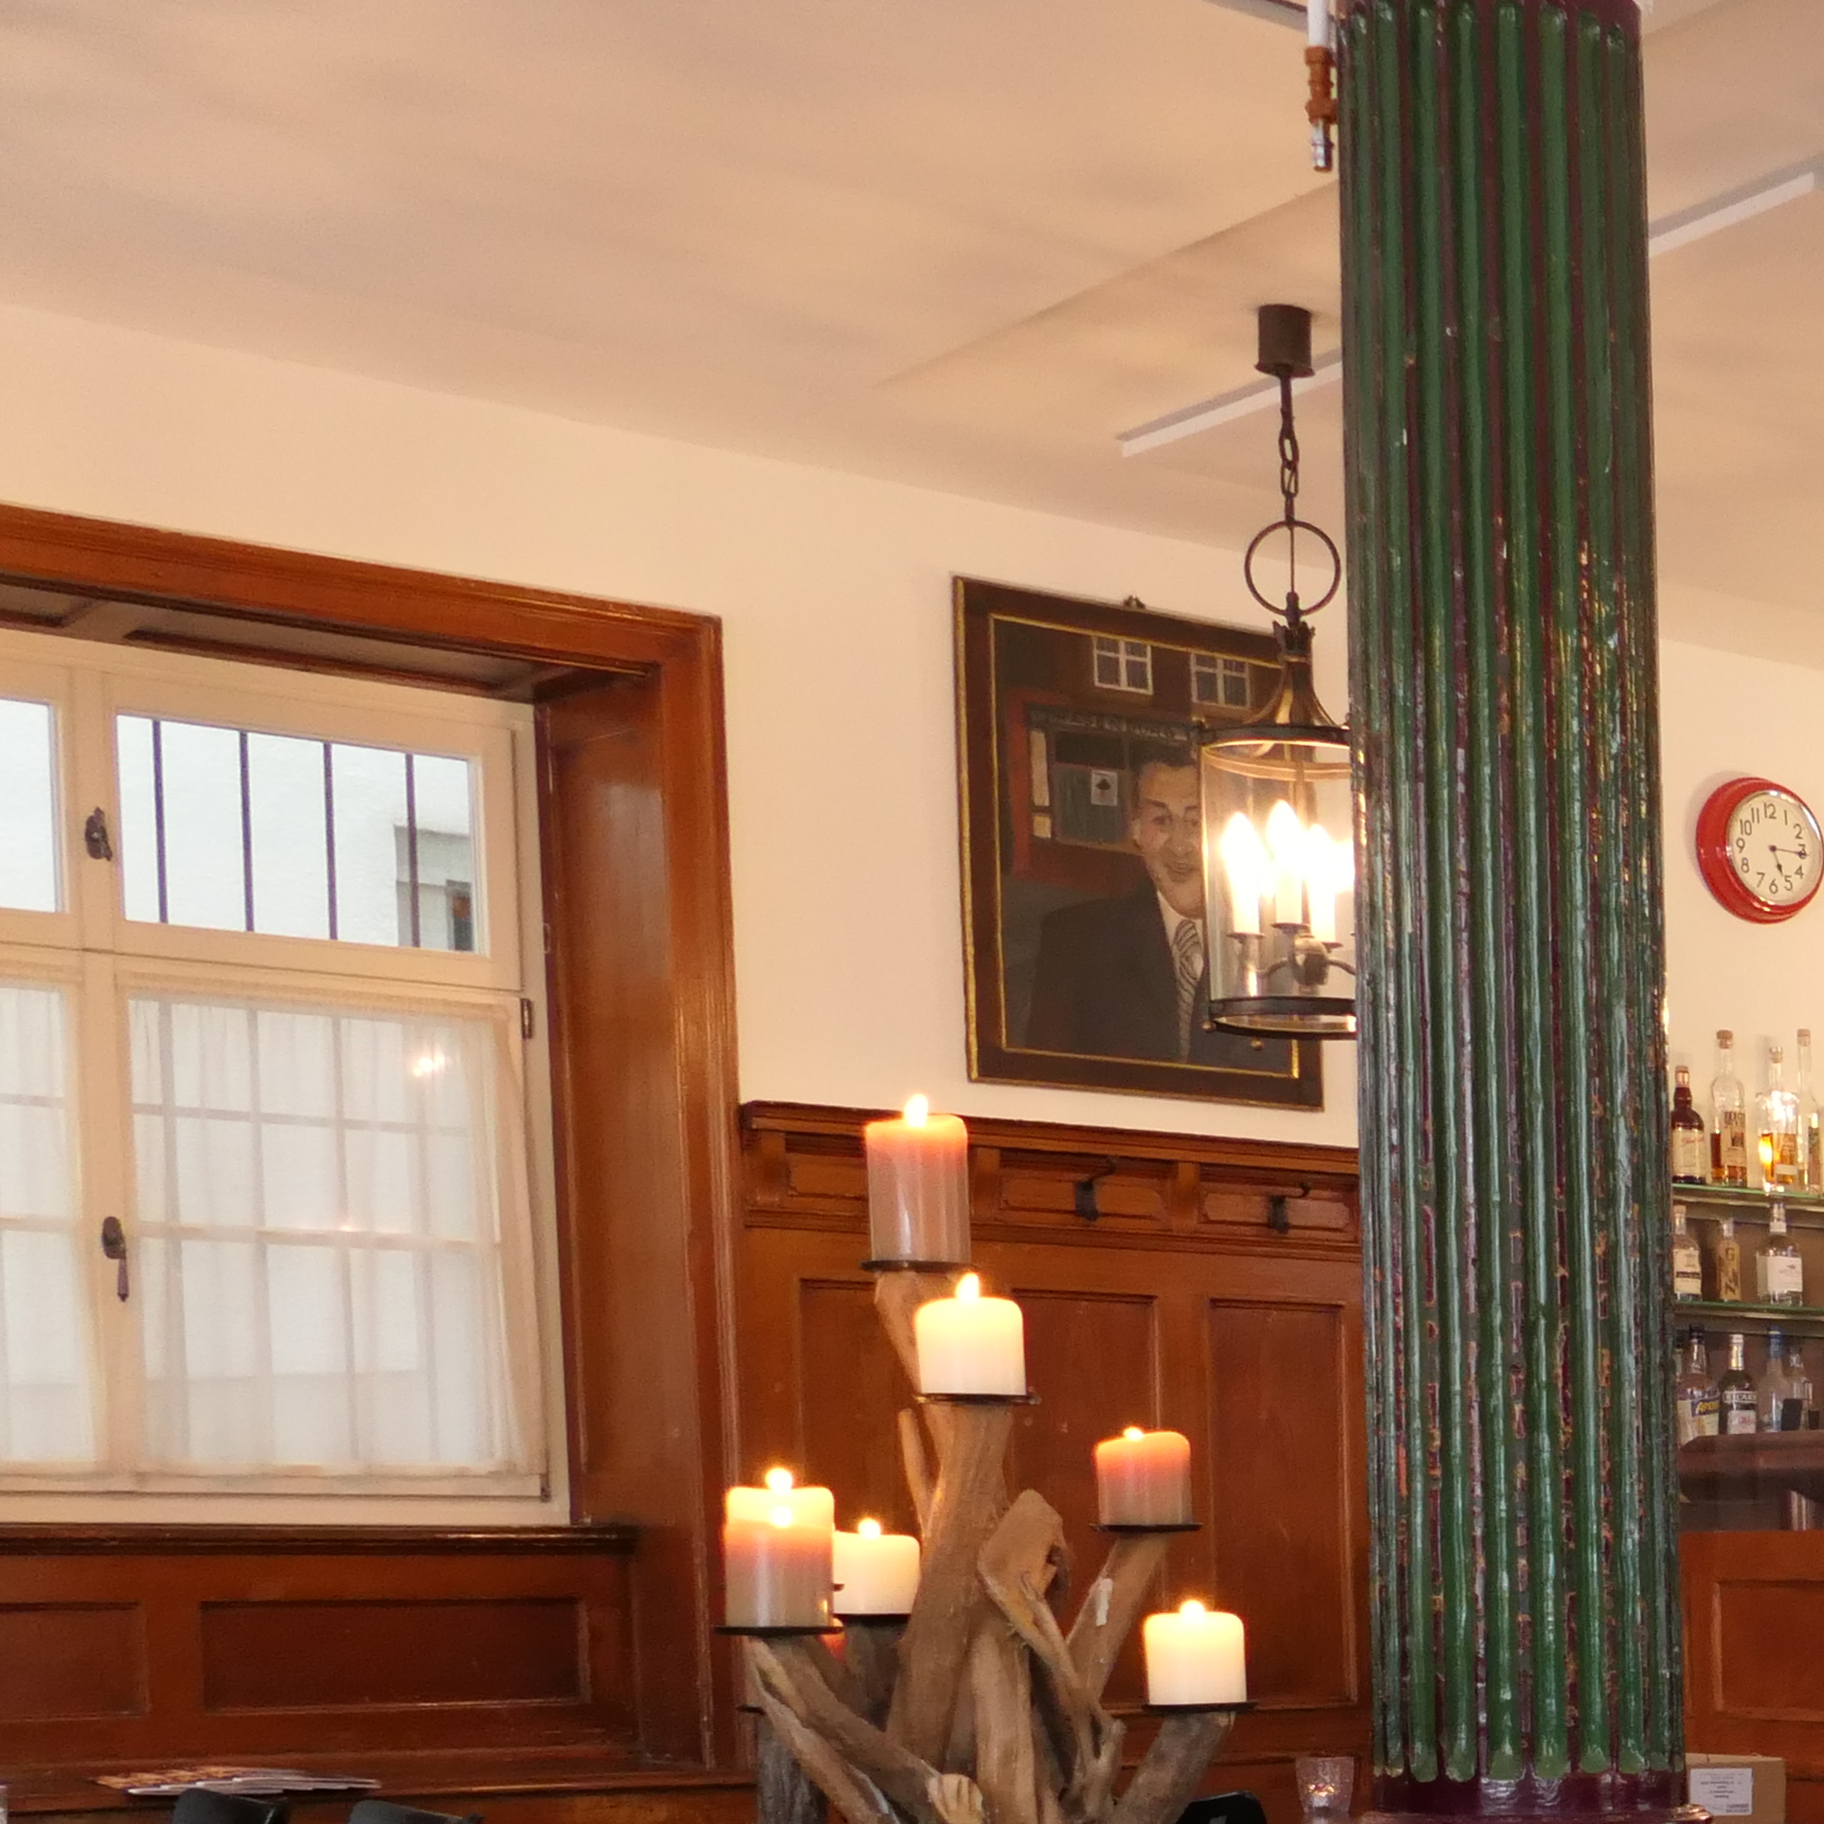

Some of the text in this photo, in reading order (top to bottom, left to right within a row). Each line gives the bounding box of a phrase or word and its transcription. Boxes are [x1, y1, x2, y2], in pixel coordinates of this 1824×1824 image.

[1750, 807, 1760, 824] 11
[1763, 801, 1777, 820] 12
[1783, 809, 1788, 826] 1
[1739, 818, 1753, 836] 10
[1793, 823, 1804, 840] 2
[1735, 837, 1746, 854] 9
[1797, 843, 1807, 860] 3
[1740, 857, 1750, 874] 8
[1794, 865, 1804, 880] 4
[1756, 871, 1766, 888] 7
[1768, 879, 1779, 895] 6
[1784, 875, 1794, 891] 5
